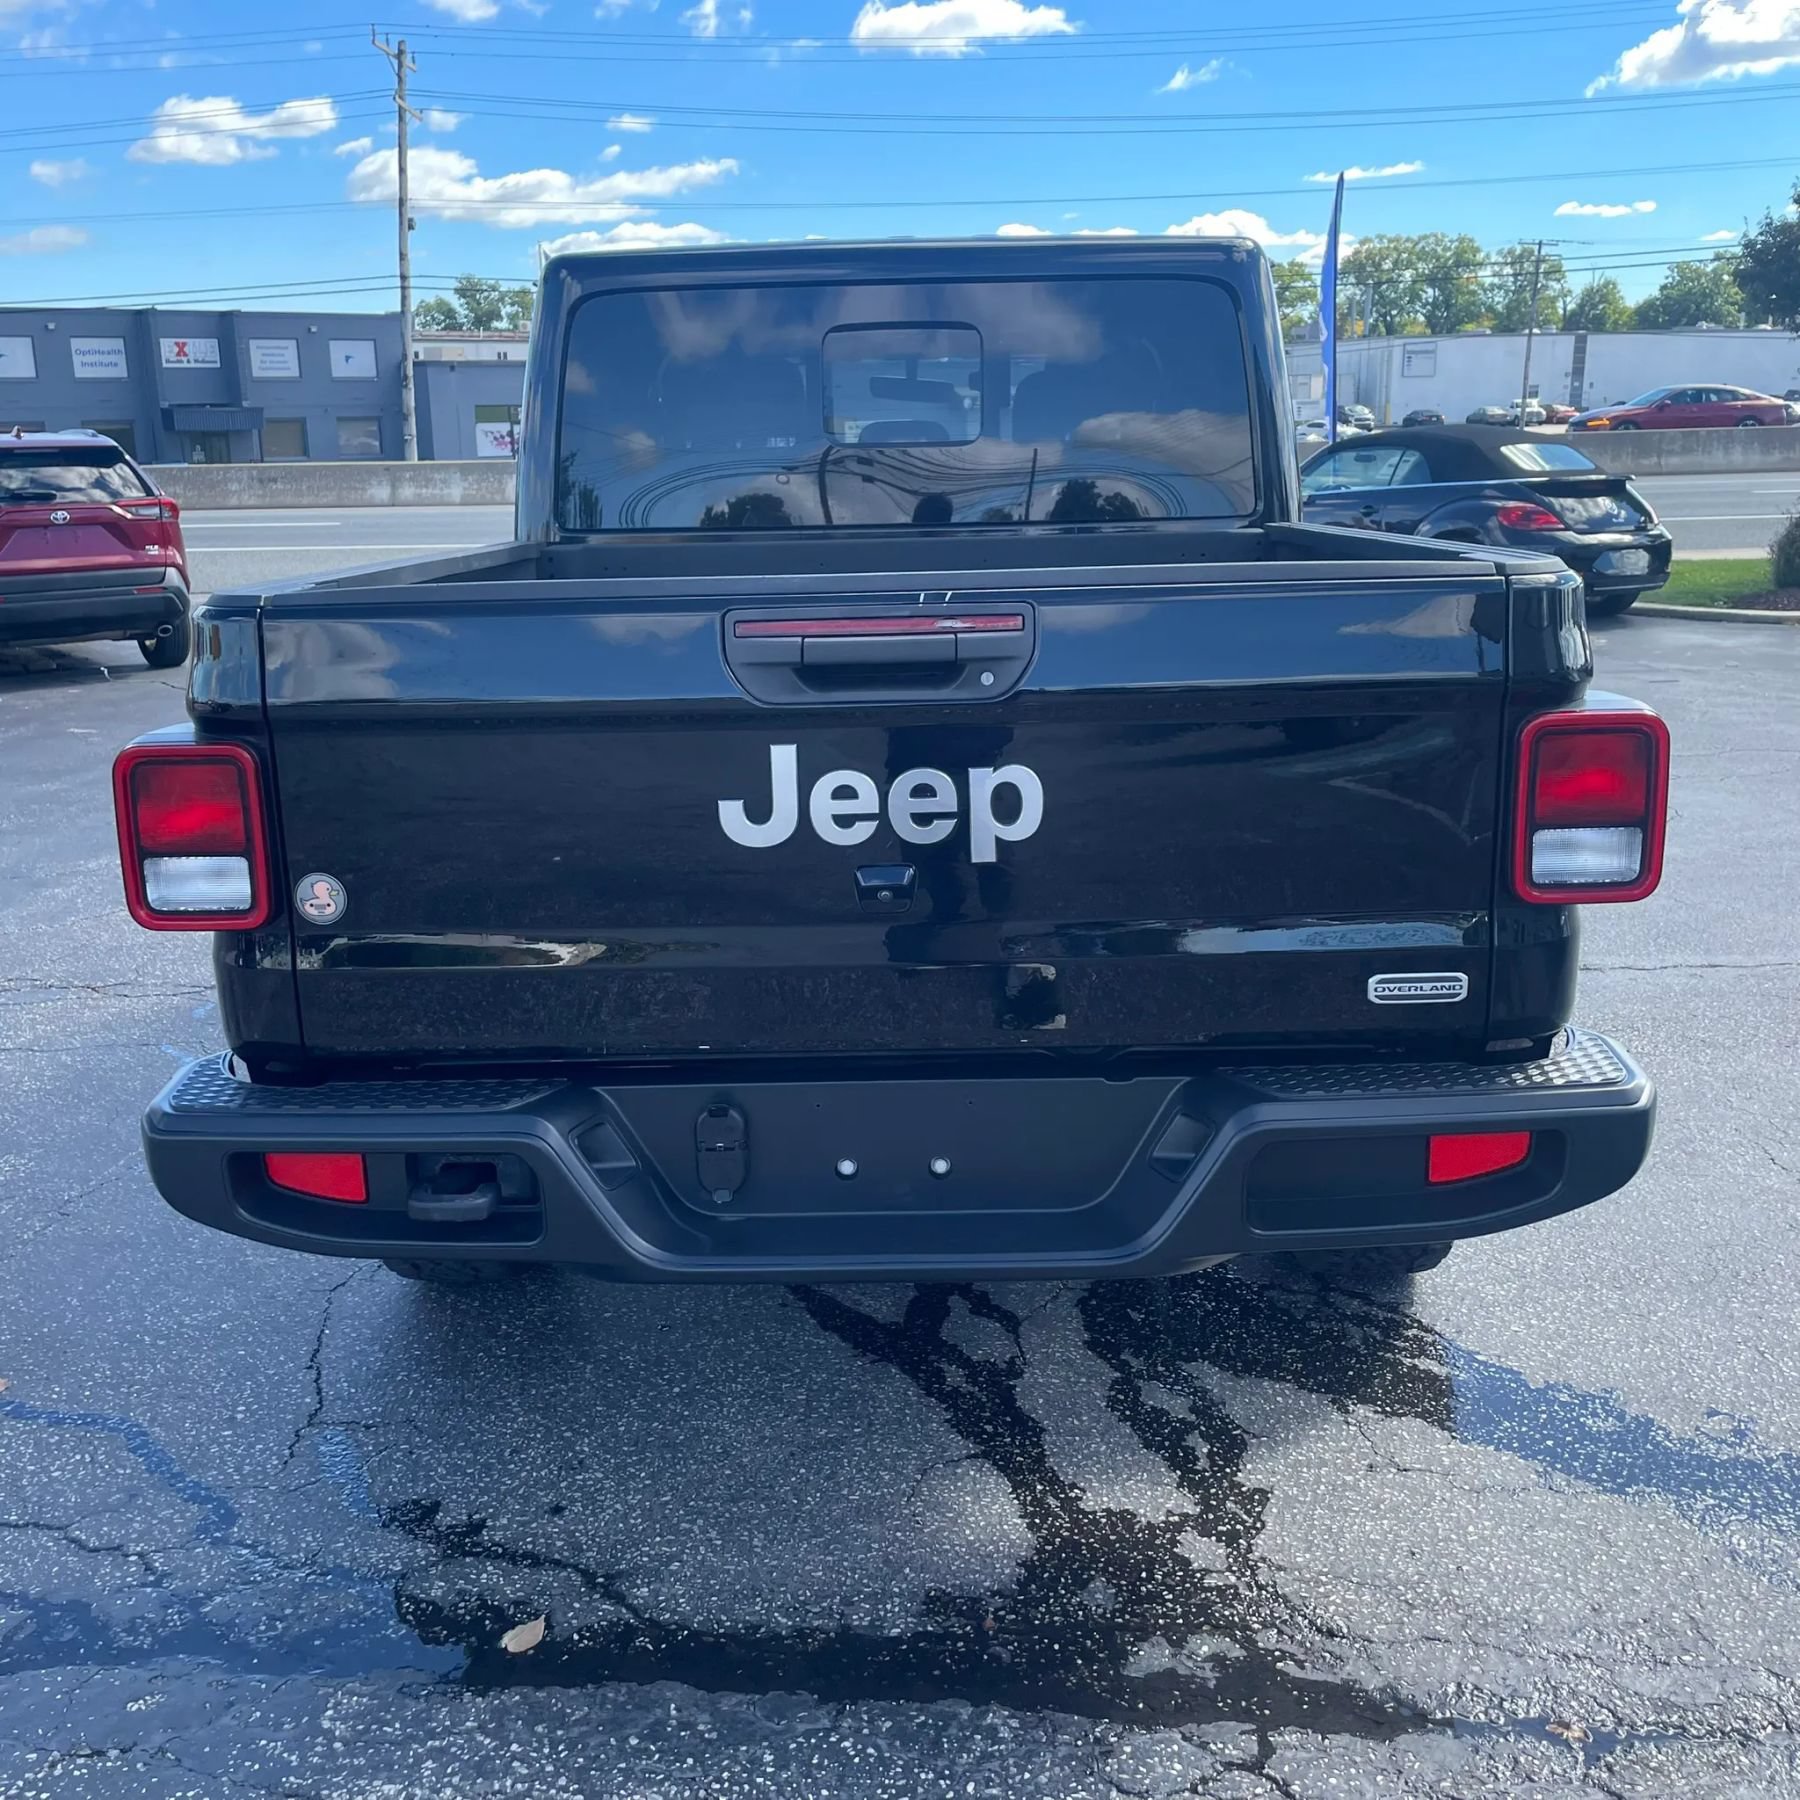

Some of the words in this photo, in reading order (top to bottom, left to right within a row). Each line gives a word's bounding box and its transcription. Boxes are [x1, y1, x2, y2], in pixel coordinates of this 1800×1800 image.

[74, 348, 124, 357] OptiHealth
[80, 360, 119, 368] Institute
[717, 743, 1044, 864] Jeep
[1374, 984, 1463, 993] OVERLAND
